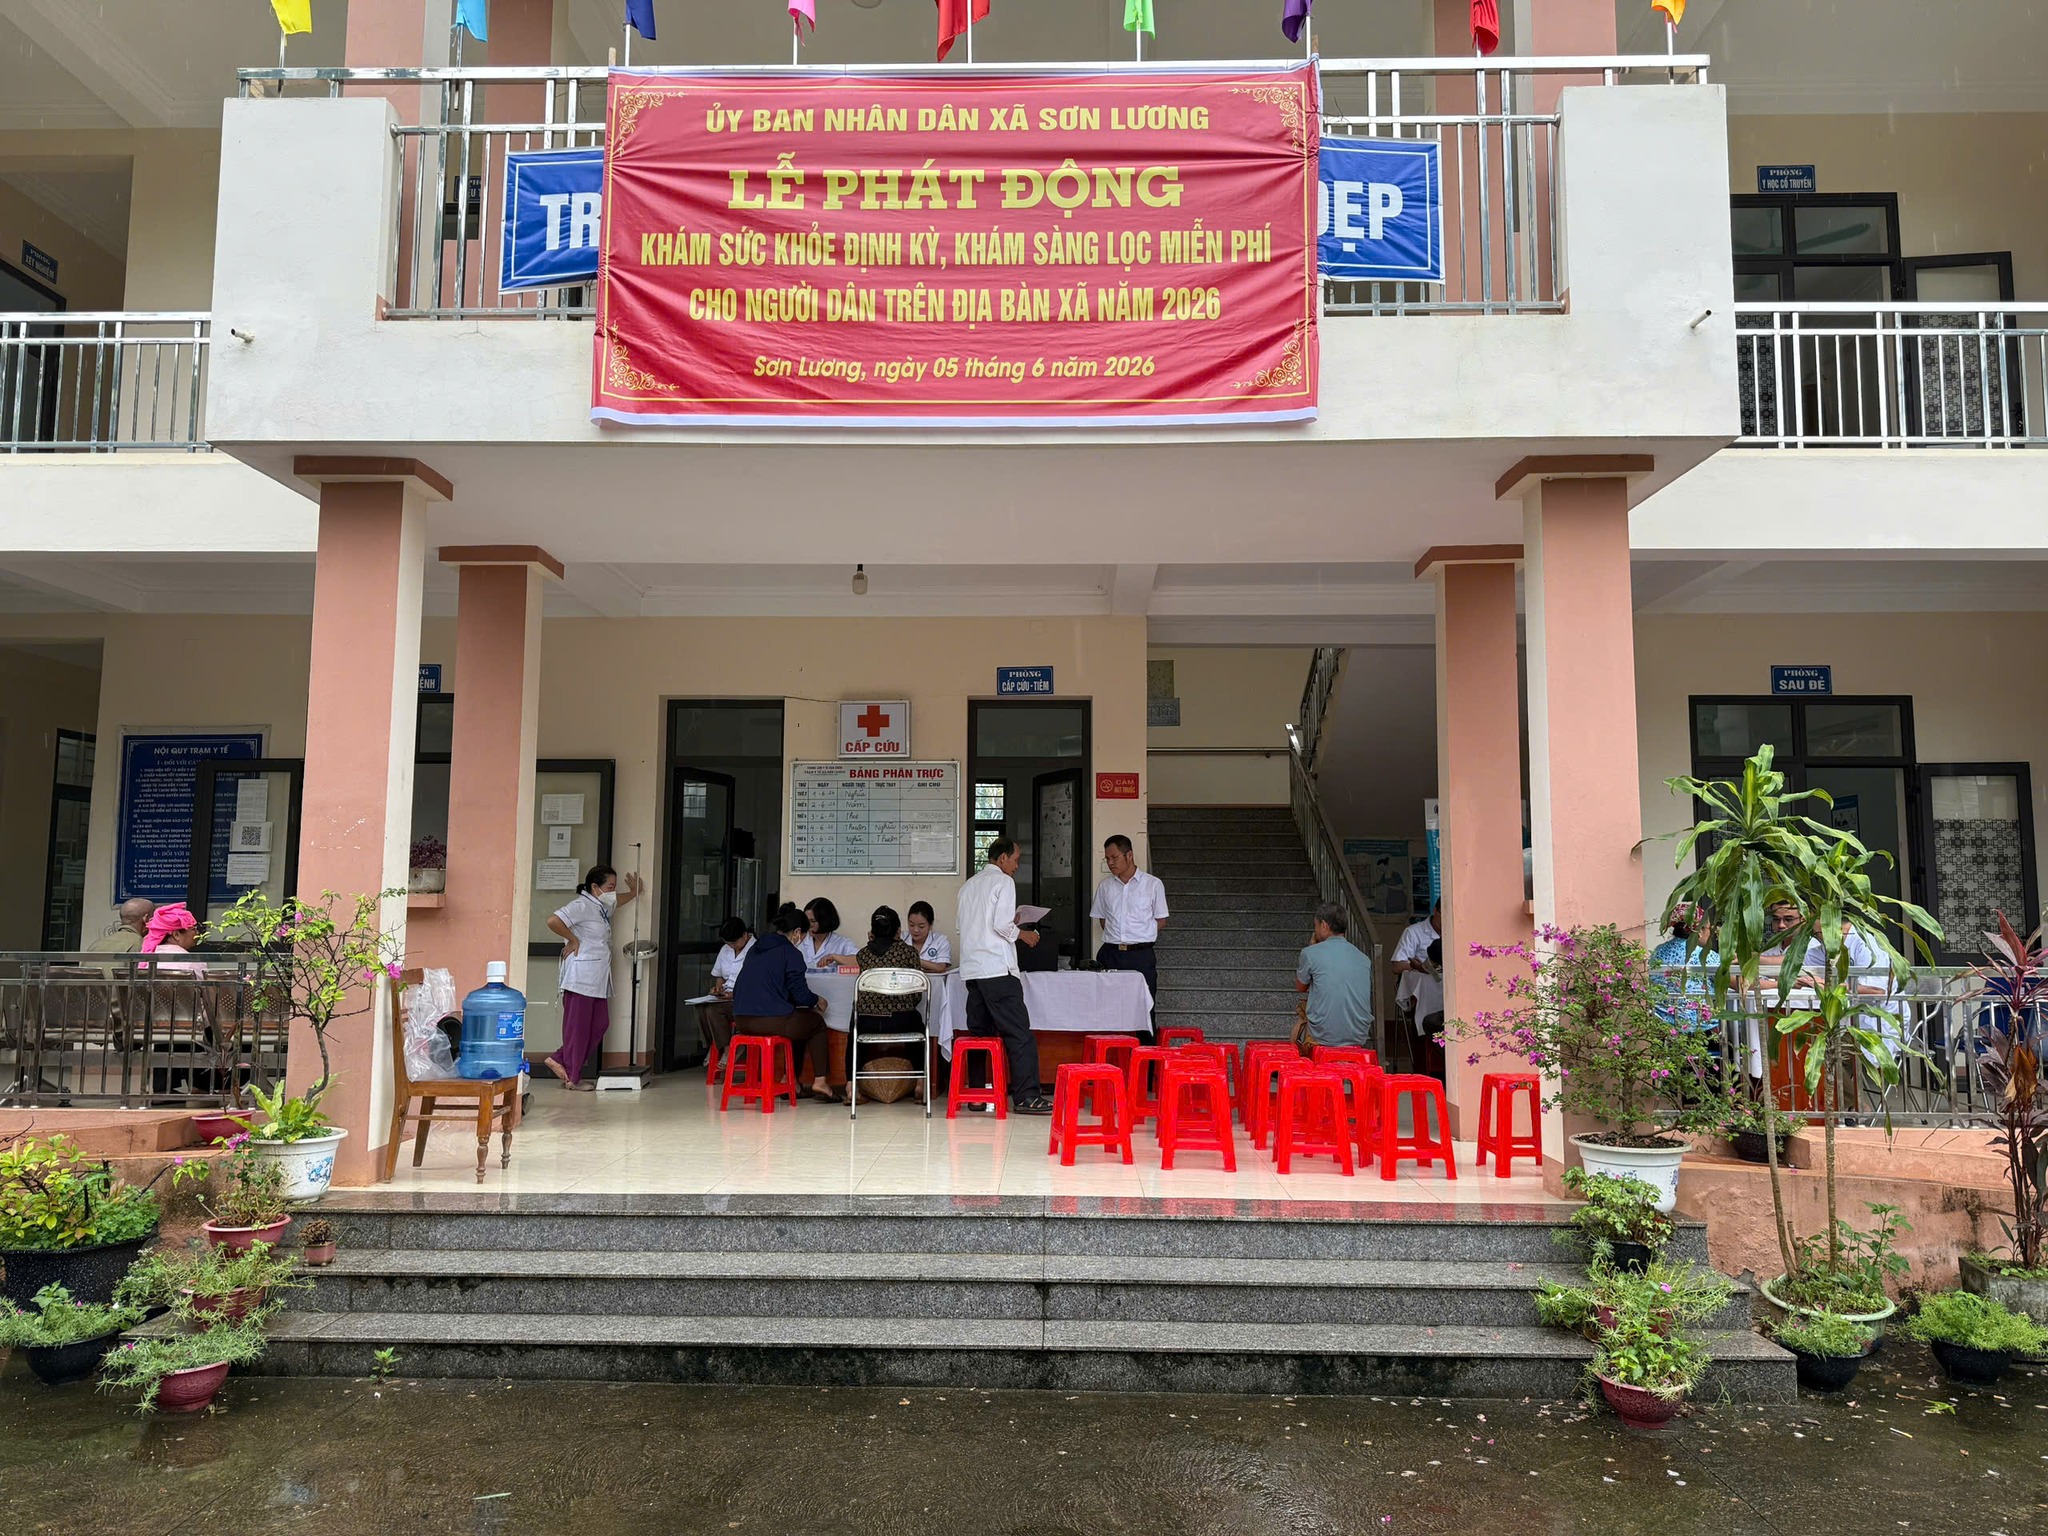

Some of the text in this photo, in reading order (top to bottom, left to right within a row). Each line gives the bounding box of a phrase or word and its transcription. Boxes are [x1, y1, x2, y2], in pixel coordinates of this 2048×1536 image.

[707, 102, 1209, 132] ỦY BAN NHÂN DÂN XÃ SƠN LƯƠNG
[728, 152, 1185, 218] LỄ PHÁT ĐỘNG
[1762, 179, 1766, 189] Y
[641, 217, 1272, 273] KHÁM SỨC KHỎE ĐỊNH KỲ, KHÁM SÀNG LỌC MIỄN PHÍ
[690, 281, 1221, 330] CHO NGƯỜI DÂN TRÊN ĐỊA BÀN XÃ NĂM 2026
[755, 356, 1155, 383] Sơn Lương, ngày 05 tháng 6 năm 2026
[420, 677, 435, 691] ỆNH
[1002, 679, 1015, 691] CẤP
[1779, 676, 1825, 690] SAU ĐẺ
[154, 746, 169, 755] NỘI
[171, 747, 188, 755] QUY
[190, 747, 211, 755] TRẠM
[220, 744, 230, 754] TẾ
[845, 739, 900, 752] CẤP CỨU
[849, 766, 879, 778] BẢNG
[883, 767, 913, 778] PHÂN
[916, 768, 944, 780] TRỰC
